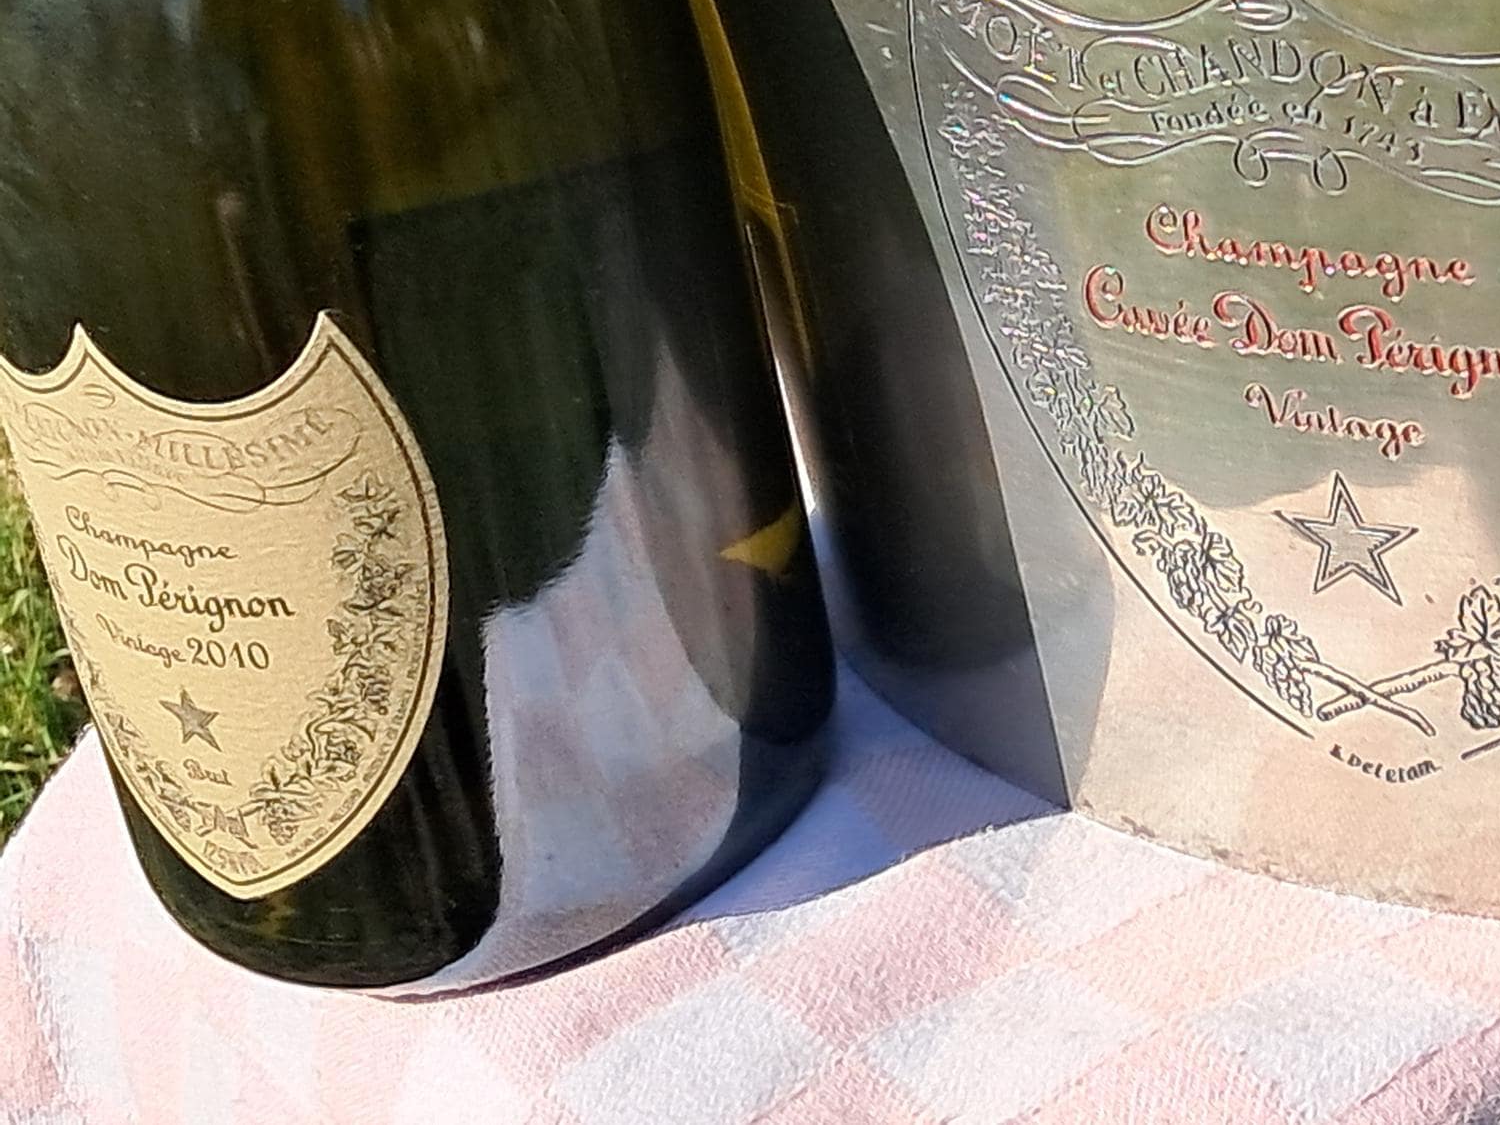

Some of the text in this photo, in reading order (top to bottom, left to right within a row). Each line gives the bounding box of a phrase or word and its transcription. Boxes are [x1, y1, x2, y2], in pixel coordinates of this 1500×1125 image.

[1133, 36, 1404, 115] CHANDON
[1145, 202, 1476, 302] Champagne
[1082, 263, 1218, 349] Cuvée
[1211, 289, 1343, 365] Dom
[1243, 382, 1427, 461] Vintage
[64, 504, 240, 568] Champagne
[56, 533, 297, 634] Dom Pérignon
[94, 611, 270, 671] Vintage 2010
